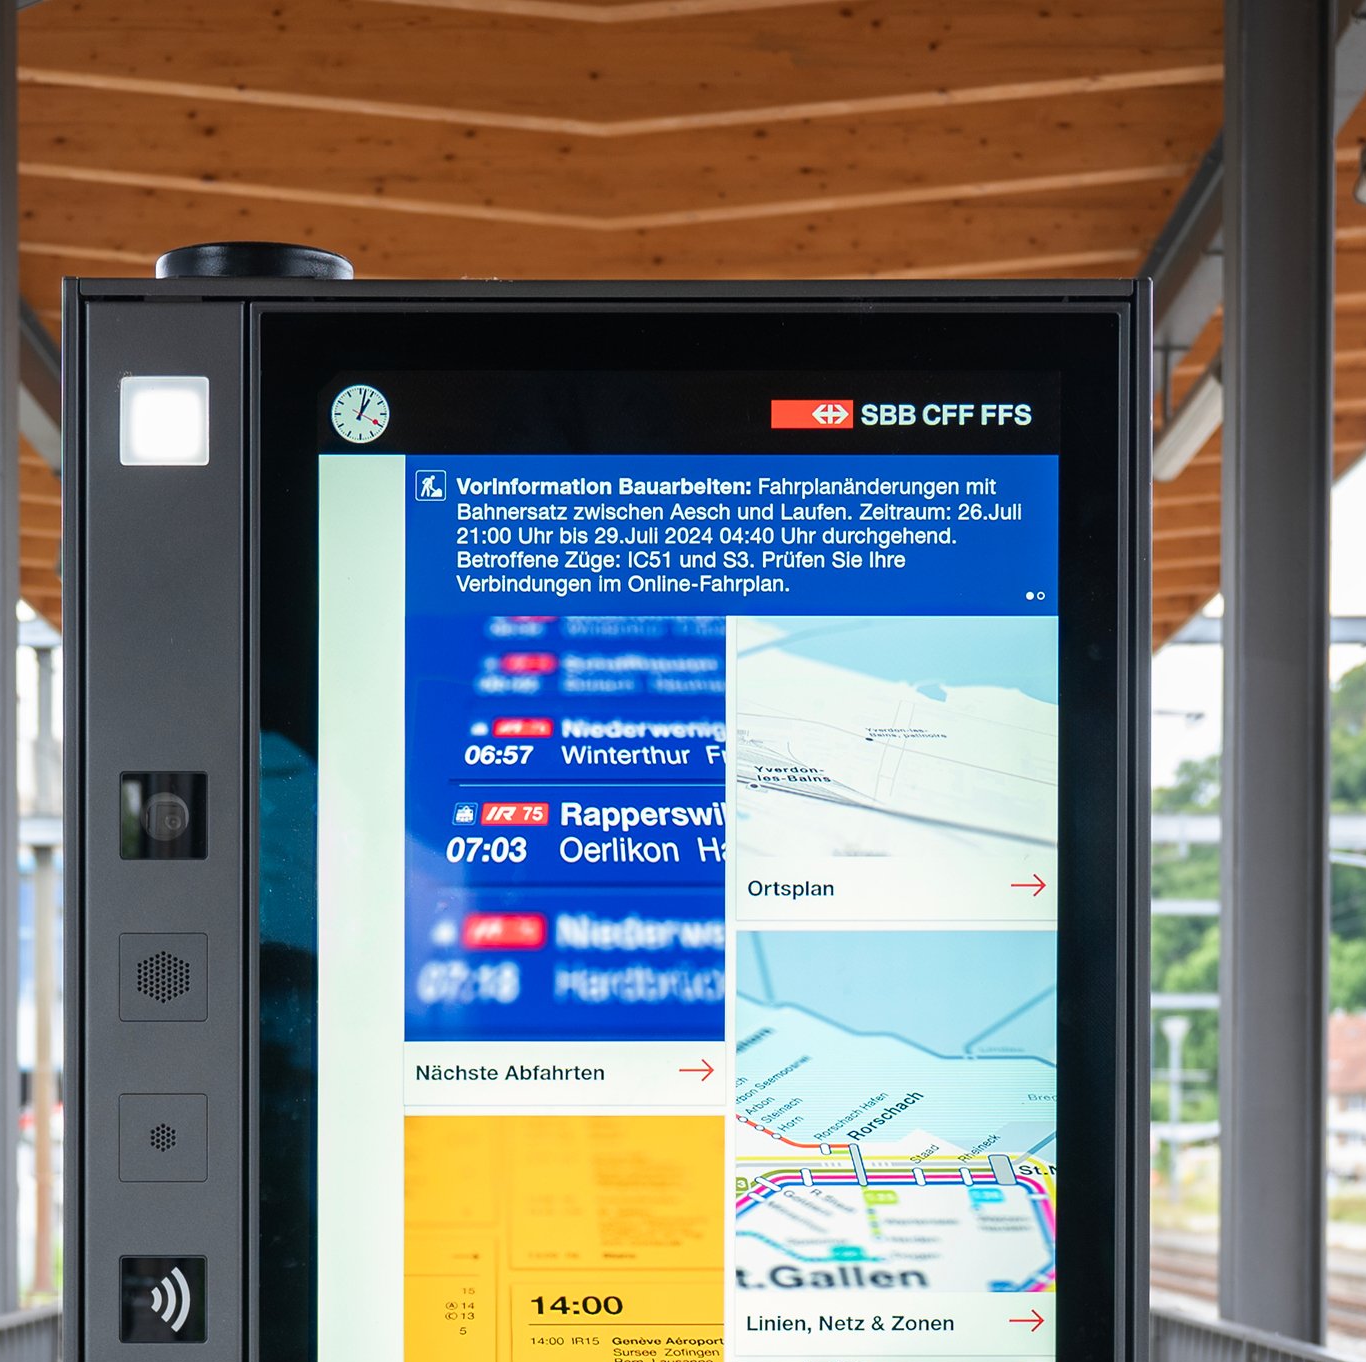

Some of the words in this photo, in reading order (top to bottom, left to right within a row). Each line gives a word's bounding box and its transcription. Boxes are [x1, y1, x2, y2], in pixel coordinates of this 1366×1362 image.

[861, 404, 916, 425] SBB
[923, 404, 974, 425] CFF
[981, 404, 1031, 425] FFS
[457, 478, 611, 494] Vorinformation
[619, 478, 751, 494] Bauarbeiten:
[759, 478, 959, 499] Fahrplanänderungen
[967, 478, 996, 494] mit
[458, 503, 567, 520] Bahnersatz
[574, 503, 663, 520] zwischen
[670, 503, 730, 520] Aesch
[738, 503, 773, 520] und
[782, 503, 852, 520] Laufen.
[860, 503, 950, 520] Zeitraum:
[958, 504, 1021, 520] 26.Juli
[457, 527, 511, 544] 21:00
[519, 527, 553, 544] Uhr
[560, 527, 588, 544] bis
[595, 527, 657, 544] 29.Juli
[665, 527, 713, 544] 2024
[720, 527, 774, 544] 04:40
[782, 527, 816, 544] Uhr
[822, 527, 957, 549] durchgehend.
[458, 551, 558, 568] Betroffene
[565, 551, 620, 572] Züge:
[629, 551, 670, 568] IC51
[680, 551, 715, 568] und
[723, 551, 754, 568] S3.
[763, 551, 824, 568] Prüfen
[832, 551, 862, 568] Sie
[870, 551, 905, 568] Ihre
[456, 575, 591, 596] Verbindungen
[599, 575, 621, 592] im
[628, 575, 789, 596] Online-Fahrplan.
[465, 745, 533, 764] 06:57
[562, 746, 690, 764] Winterthur
[485, 806, 517, 821] IR
[522, 806, 543, 821] 75
[447, 837, 526, 863] 07:03
[560, 837, 679, 862] Oerlikon
[748, 881, 833, 900] Ortsplan
[417, 1065, 498, 1080] Nächste
[505, 1065, 604, 1080] Abfahrten
[736, 1088, 758, 1104] rbon
[745, 1095, 775, 1115] Arbon
[761, 1096, 803, 1124] Steinach
[813, 1109, 864, 1141] Rorschach
[859, 1091, 889, 1111] Hafen
[847, 1091, 924, 1141] Rorschach
[778, 1114, 804, 1132] Horn
[910, 1144, 939, 1164] Staad
[957, 1133, 1001, 1164] Rheineck
[531, 1296, 623, 1315] 14:00
[461, 1312, 475, 1320] 13
[748, 1316, 811, 1334] Linien,
[820, 1316, 864, 1330] Netz
[872, 1316, 884, 1330] &
[892, 1316, 953, 1330] Zonen
[459, 1327, 467, 1335] 5
[532, 1337, 564, 1345] 14:00
[572, 1337, 599, 1345] IR15
[612, 1337, 661, 1345] Genève
[613, 1348, 657, 1357] Sursee
[664, 1348, 720, 1359] Zofingen
